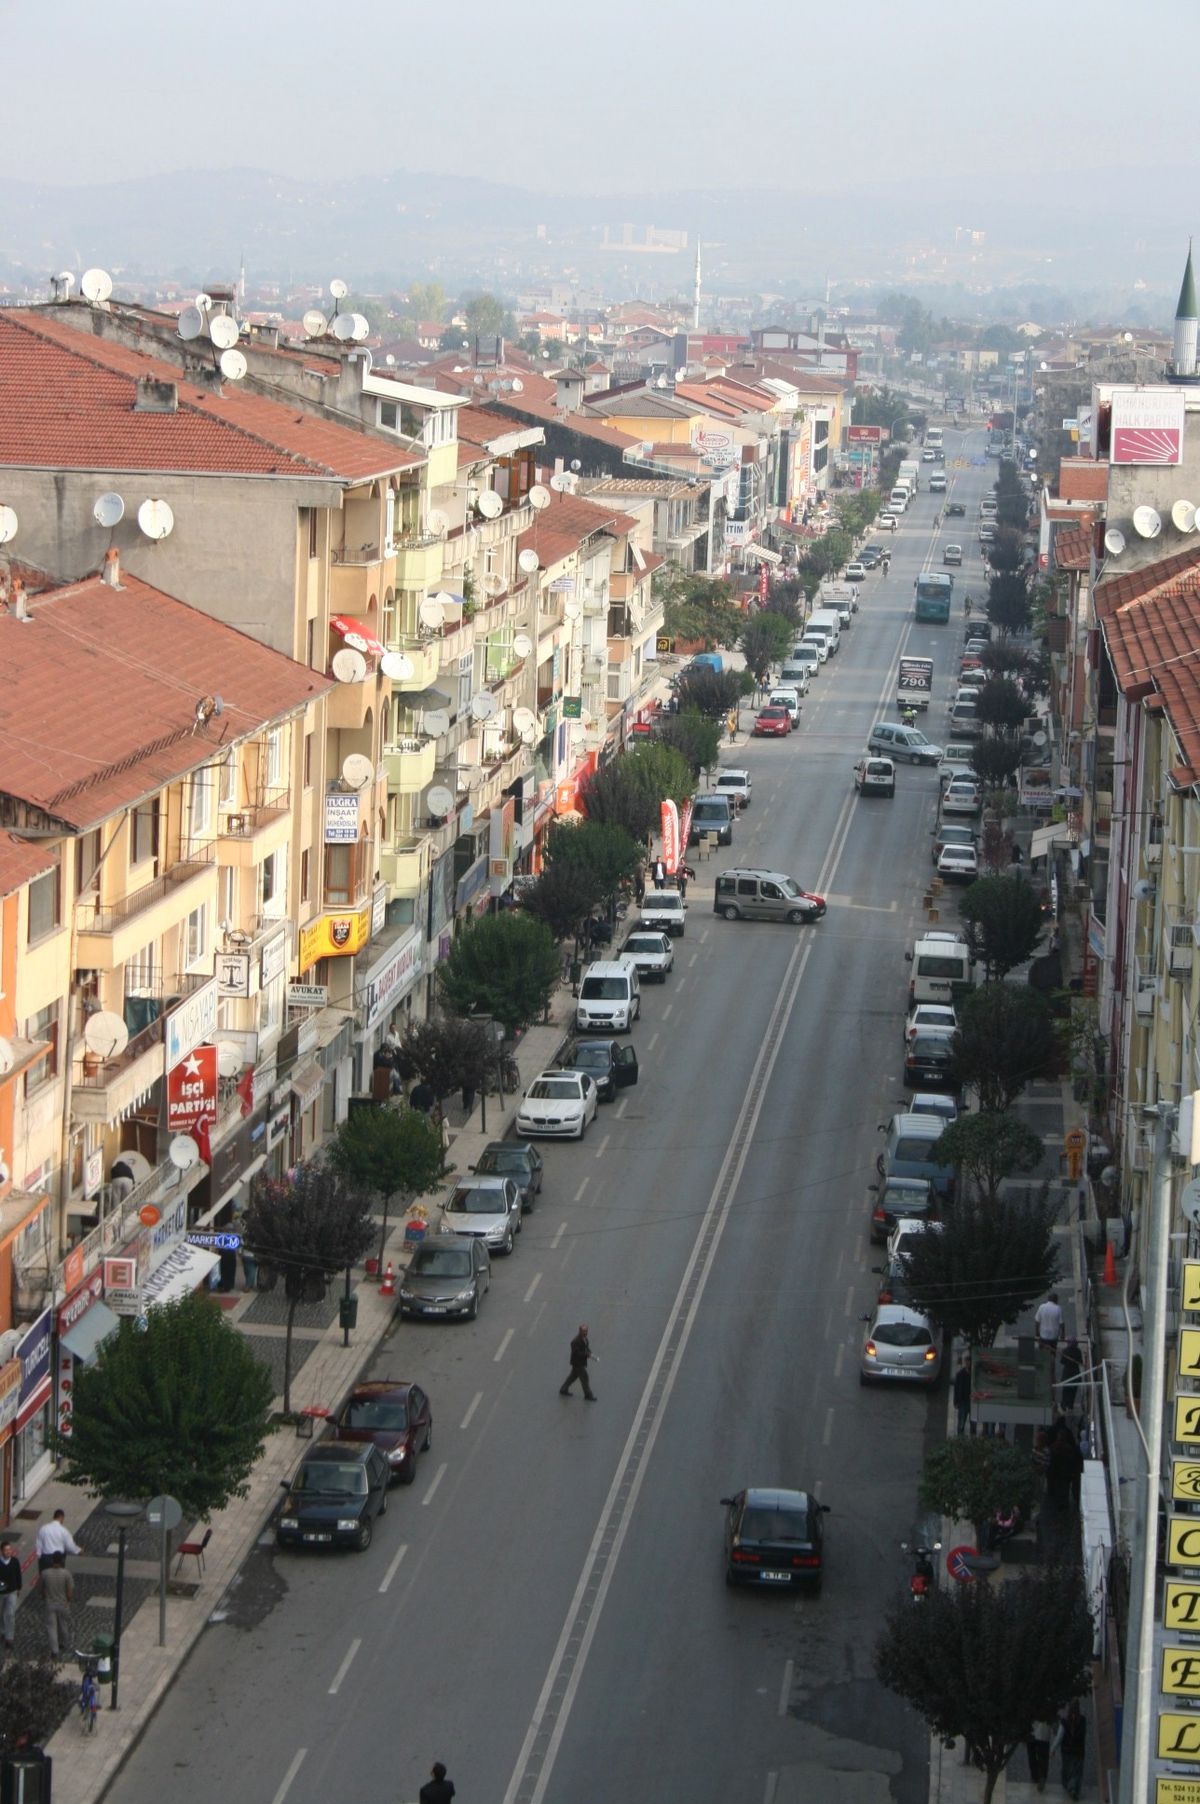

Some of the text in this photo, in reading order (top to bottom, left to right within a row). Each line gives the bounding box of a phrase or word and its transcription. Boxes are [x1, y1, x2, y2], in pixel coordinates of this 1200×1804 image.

[901, 677, 926, 687] 790
[328, 797, 357, 807] TUĞRA
[291, 986, 324, 994] AVUKAT
[181, 1079, 204, 1098] İŞÇİ
[170, 1096, 215, 1115] PARTİSİ
[111, 1265, 128, 1284] E
[25, 1333, 49, 1379] TURKCELL
[1174, 1784, 1185, 1792] 524
